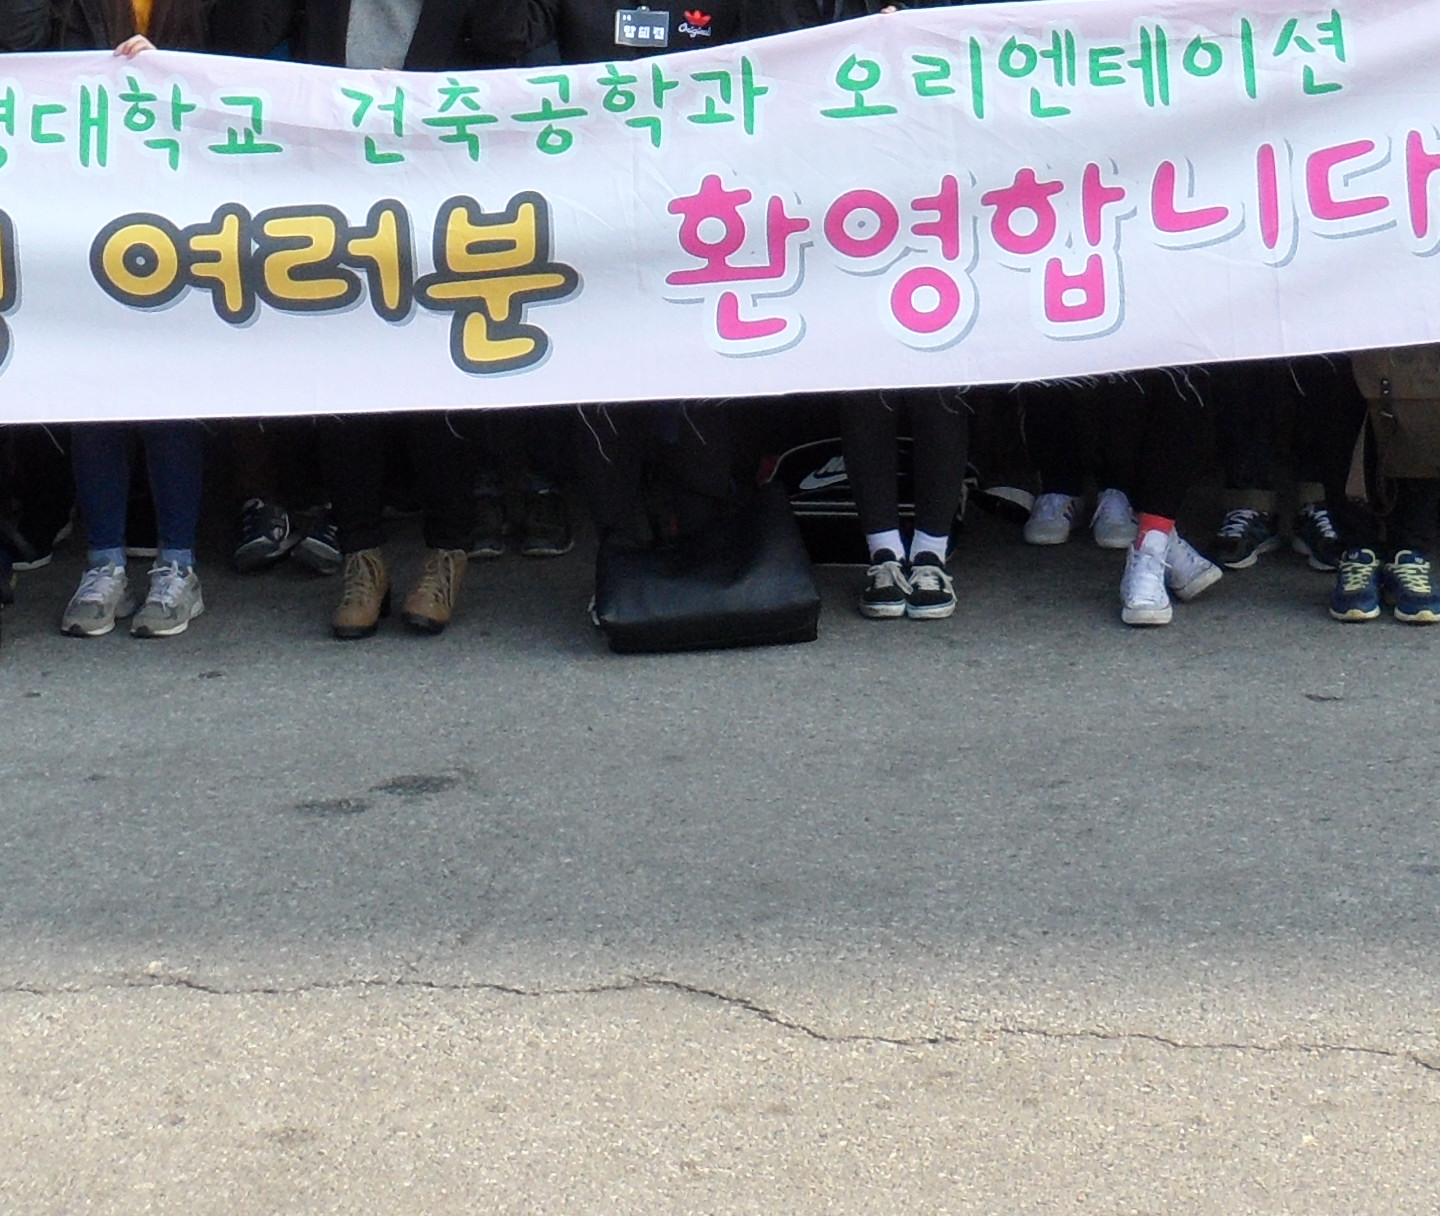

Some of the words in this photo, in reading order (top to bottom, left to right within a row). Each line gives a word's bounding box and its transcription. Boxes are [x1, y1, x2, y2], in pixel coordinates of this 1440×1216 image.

[342, 55, 769, 165] 건축공학과
[820, 8, 1346, 121] 오리엔테이션
[90, 191, 579, 375] 여러분
